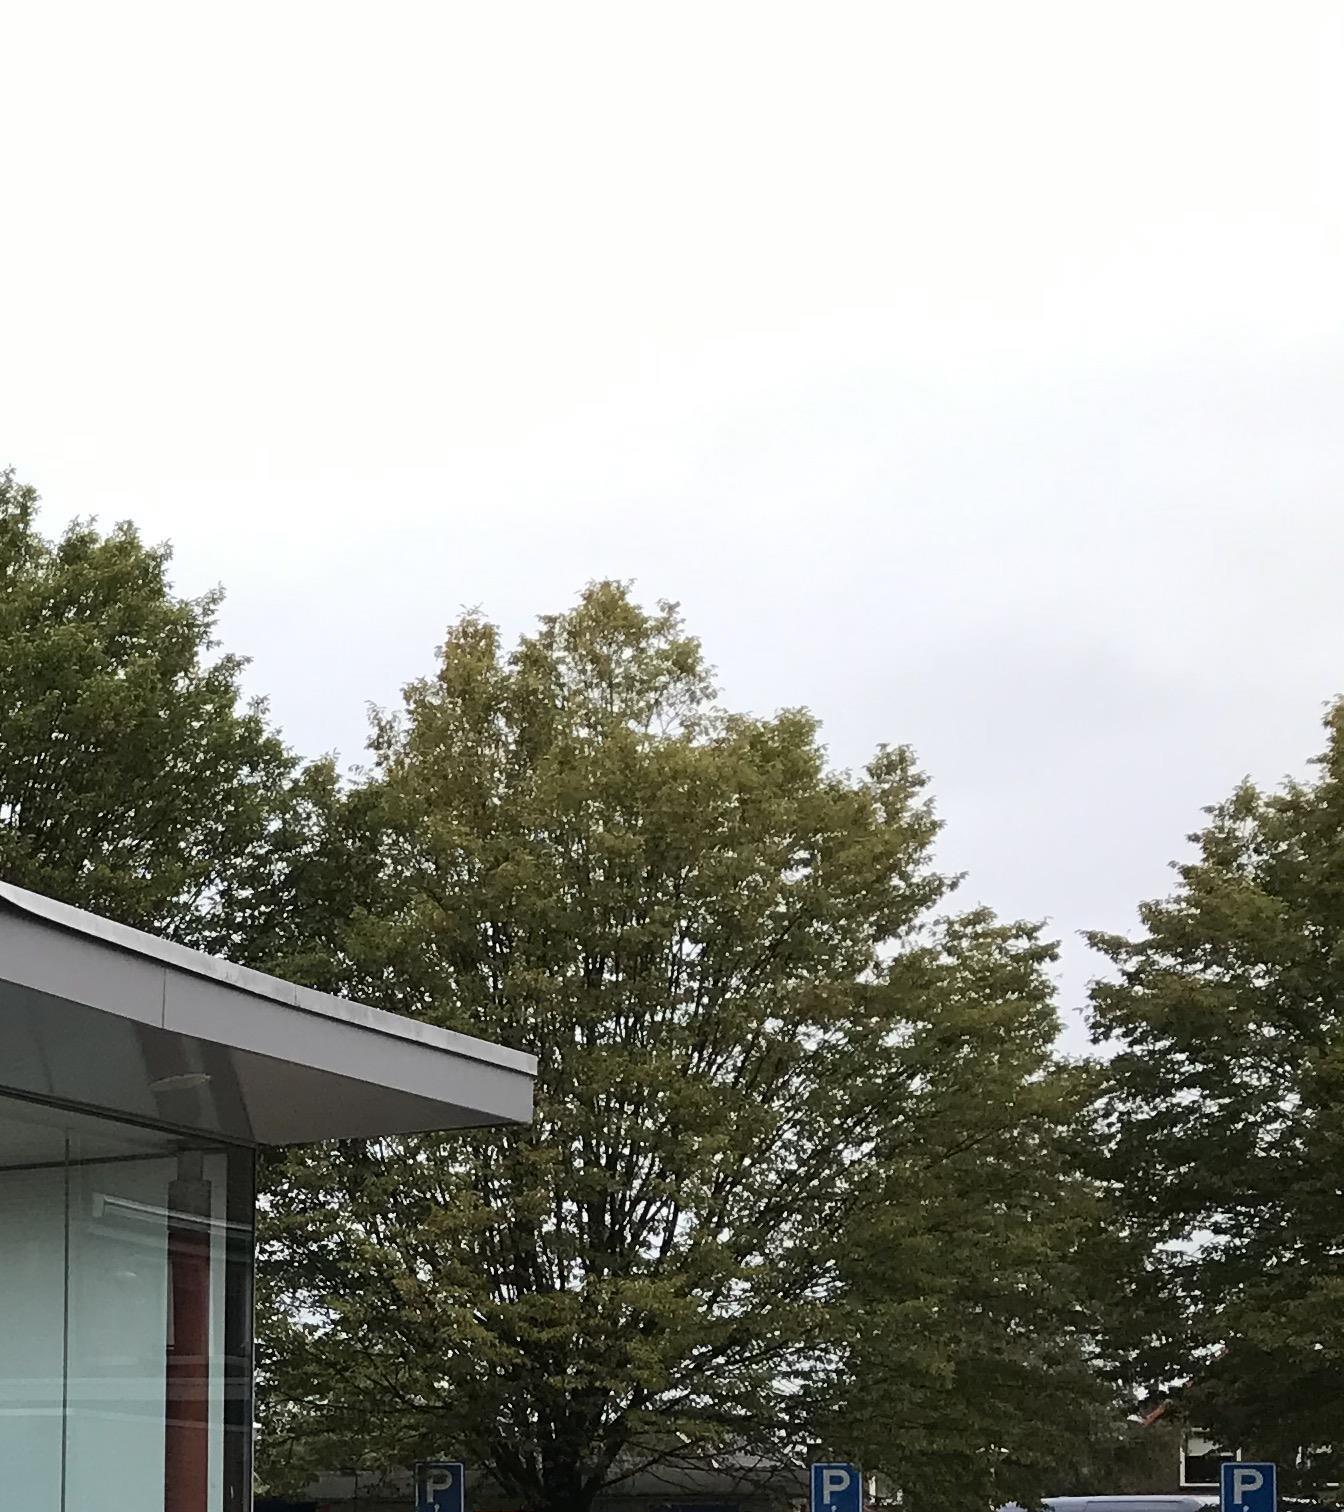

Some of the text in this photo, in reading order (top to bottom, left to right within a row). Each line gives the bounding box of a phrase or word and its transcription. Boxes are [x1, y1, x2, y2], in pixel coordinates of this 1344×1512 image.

[426, 1468, 453, 1503] P
[822, 1468, 851, 1505] P
[1233, 1468, 1264, 1505] P
